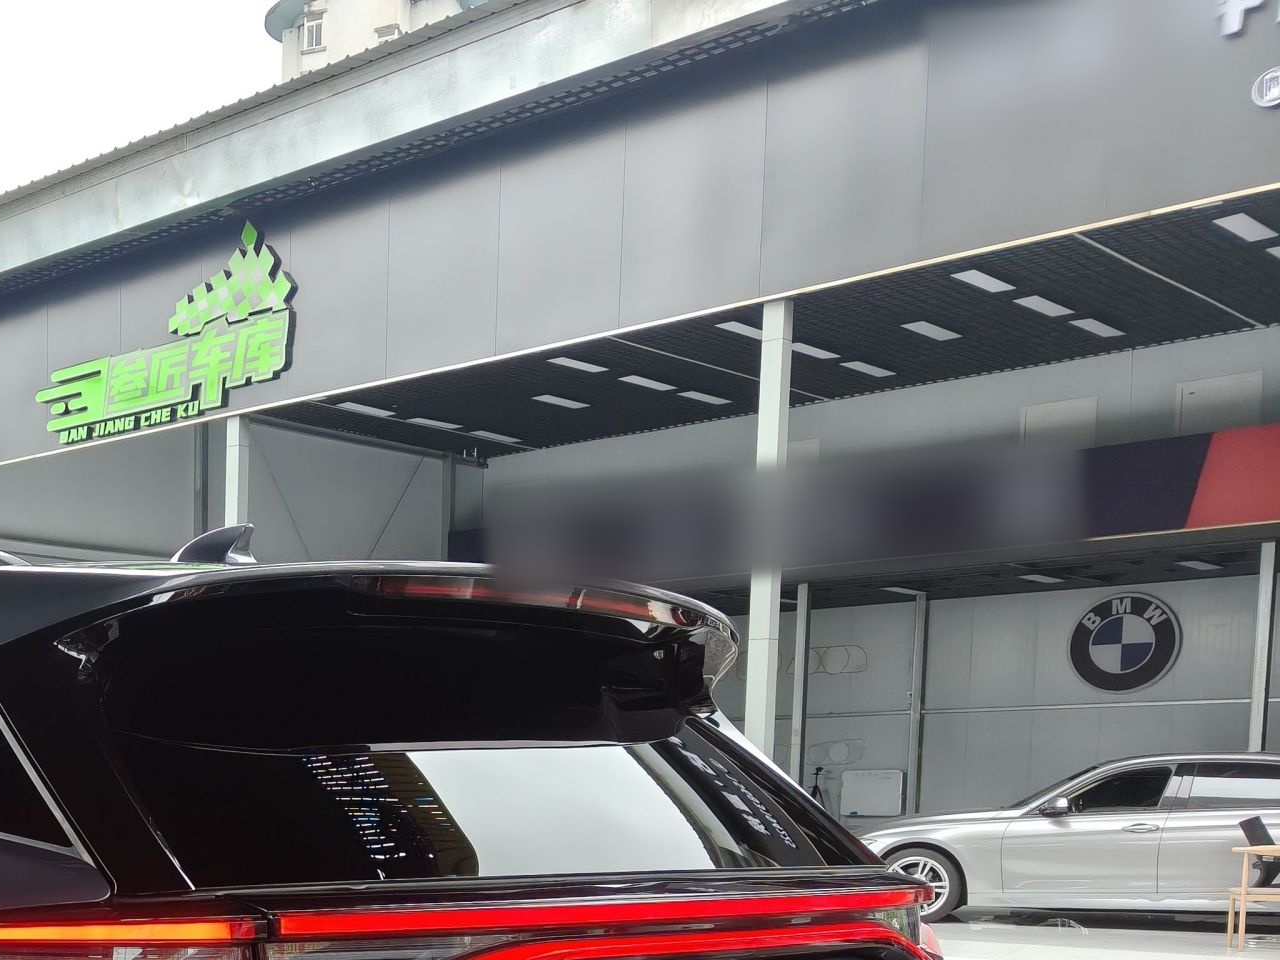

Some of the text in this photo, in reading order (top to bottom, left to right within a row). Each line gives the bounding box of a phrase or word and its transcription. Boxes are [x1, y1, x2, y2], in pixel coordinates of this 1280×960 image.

[92, 415, 135, 437] JIANG
[140, 407, 171, 427] CHE
[176, 400, 200, 418] KU
[1081, 597, 1168, 631] BMW
